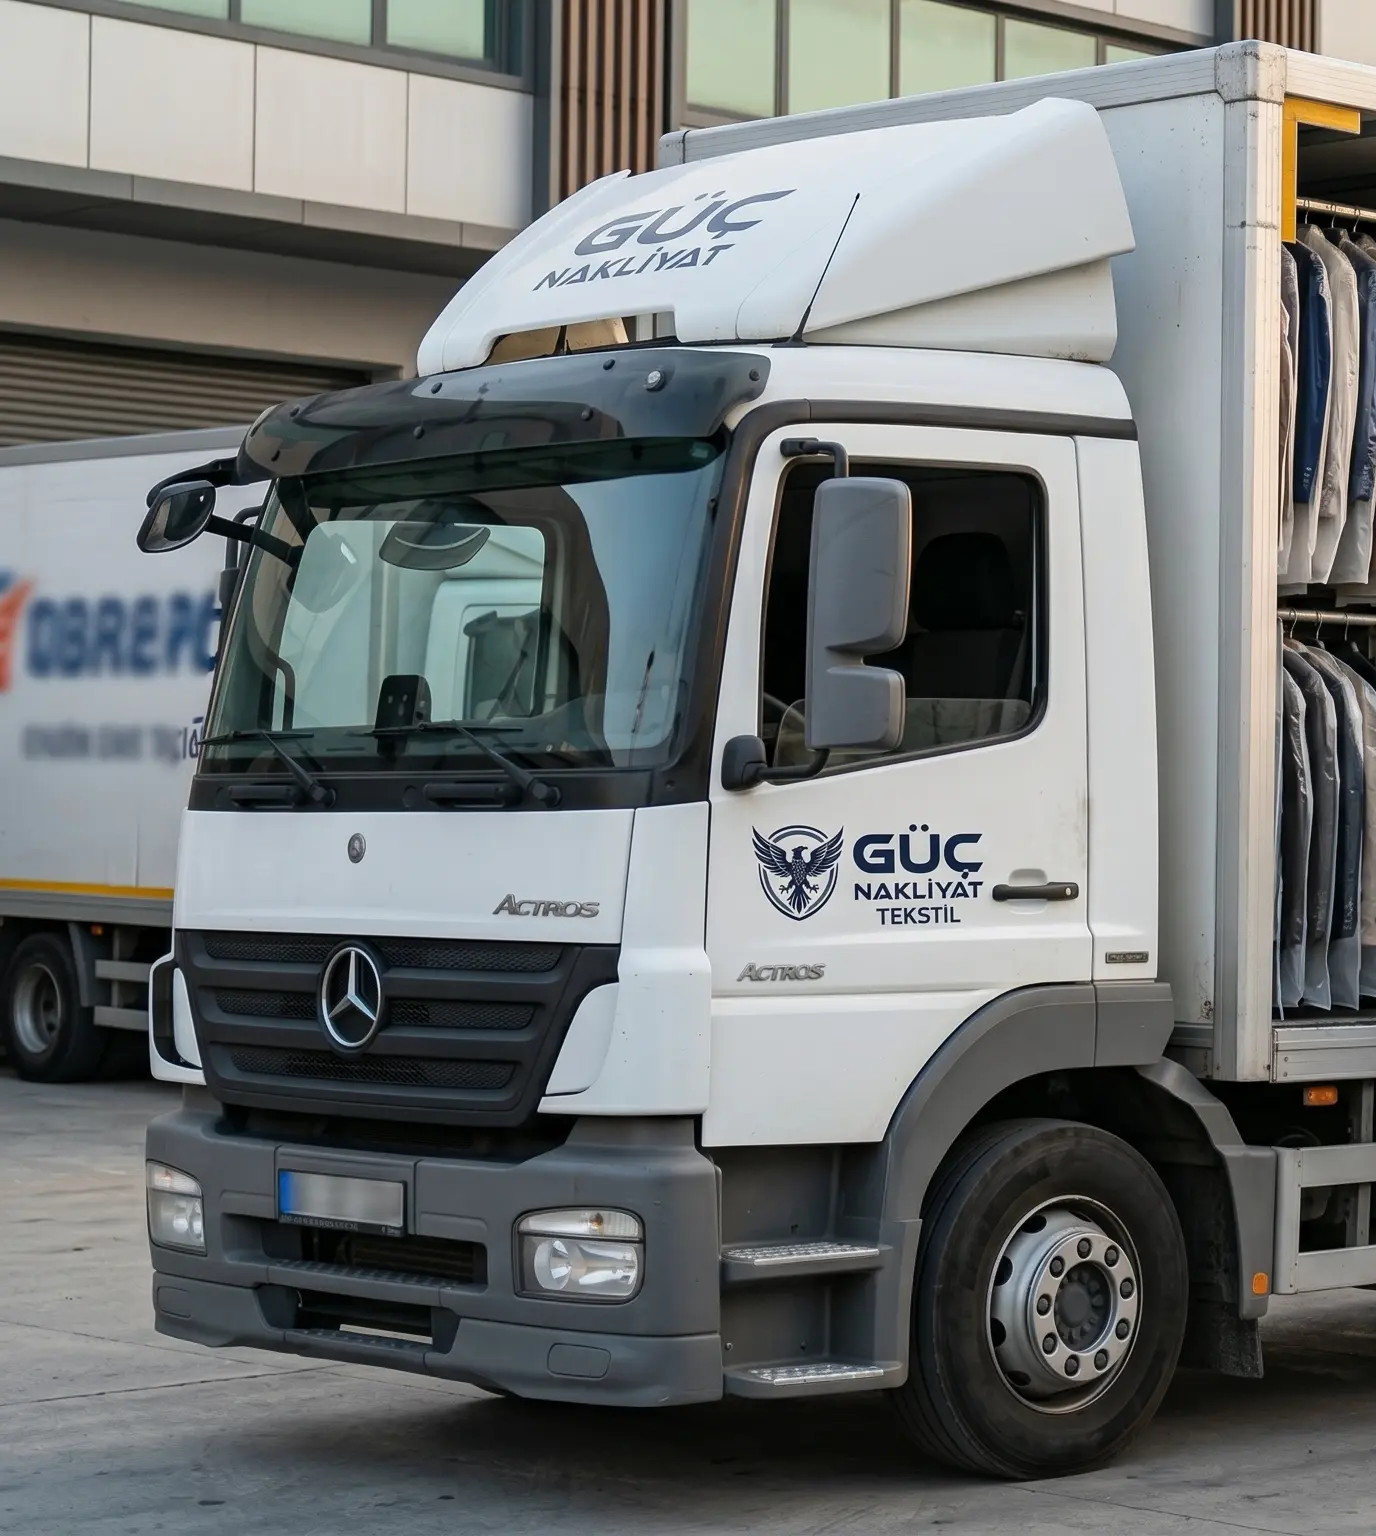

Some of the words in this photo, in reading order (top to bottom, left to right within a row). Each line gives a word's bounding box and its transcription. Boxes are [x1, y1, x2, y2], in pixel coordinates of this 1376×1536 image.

[574, 188, 797, 256] GÜÇ
[532, 244, 736, 292] NAKLİYAT
[852, 823, 984, 880] GÜÇ
[854, 877, 984, 901] NAKLİYAT
[875, 904, 961, 926] TEKSTİL
